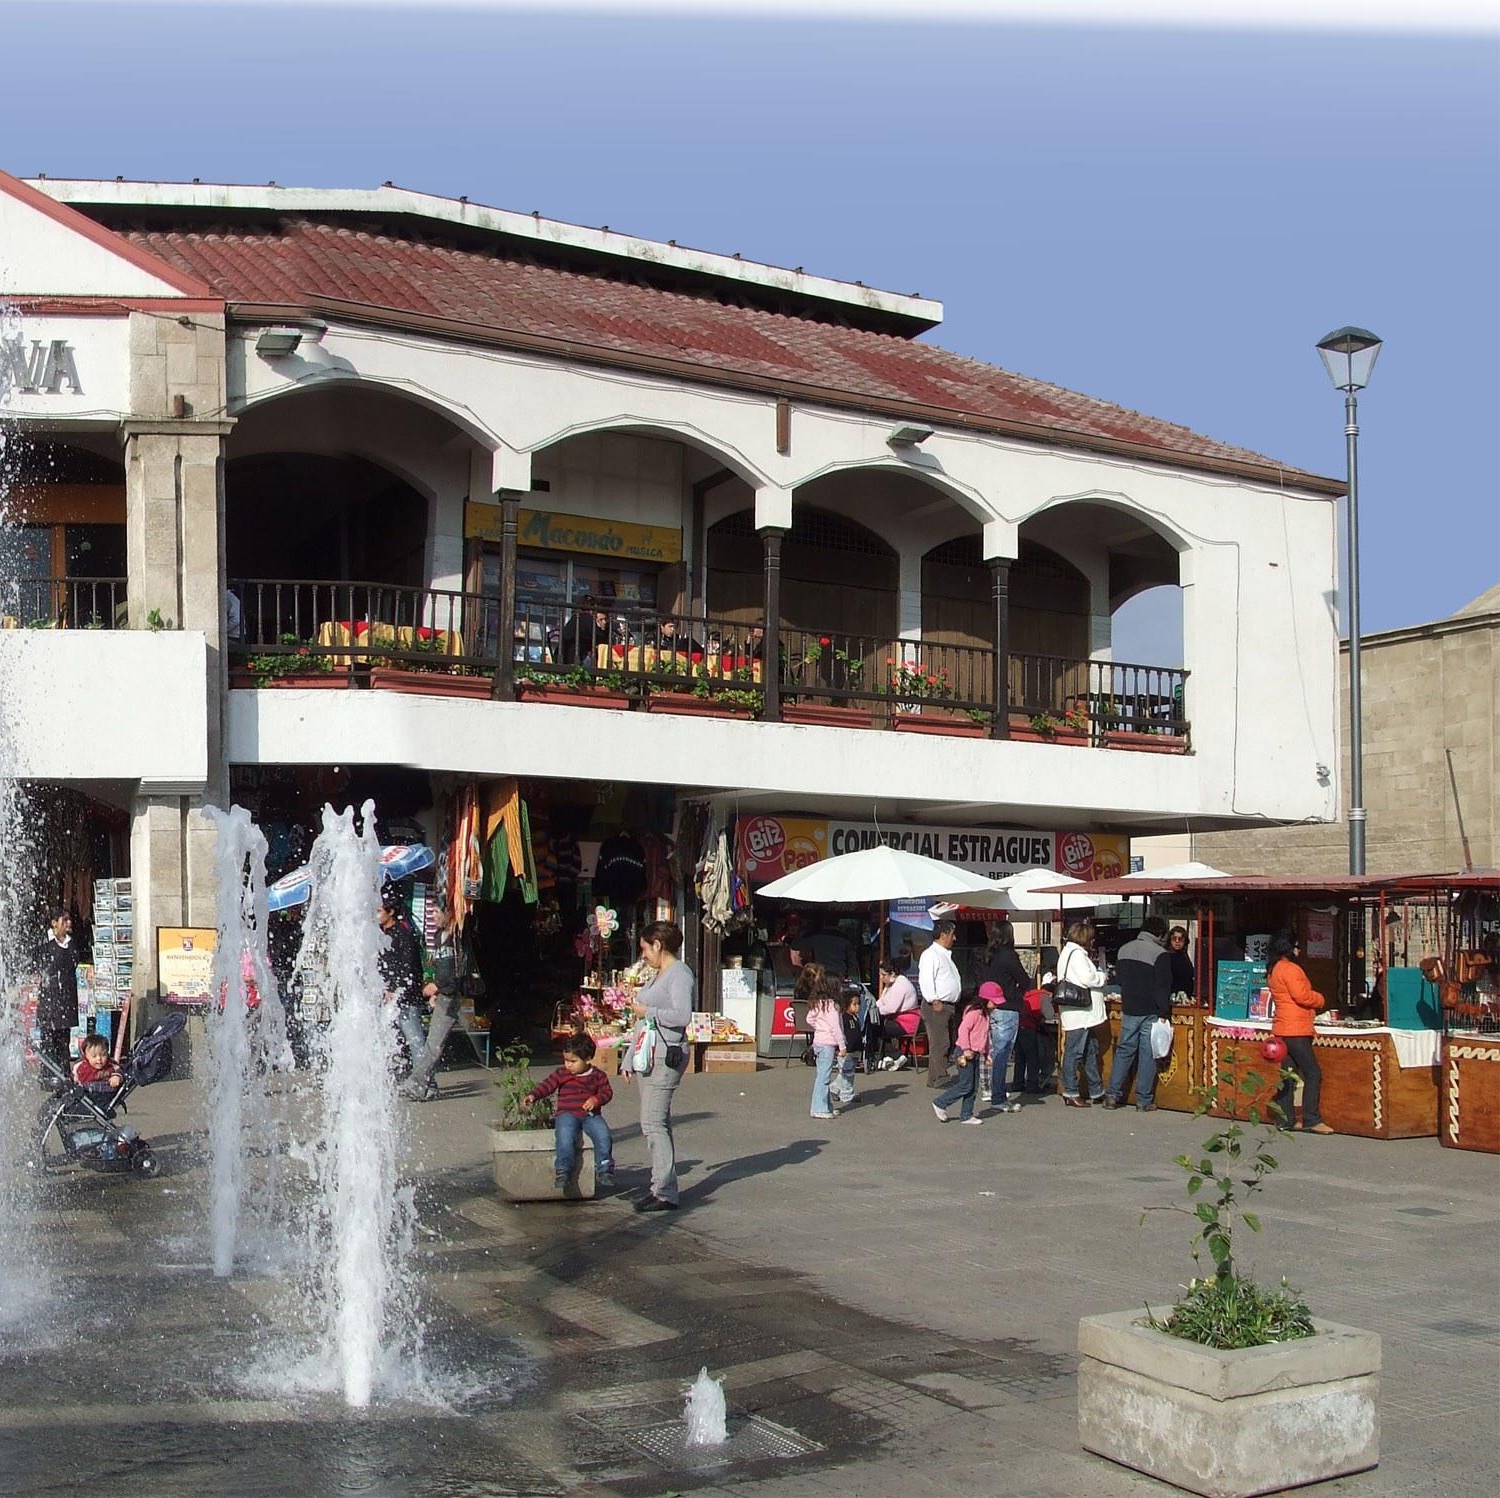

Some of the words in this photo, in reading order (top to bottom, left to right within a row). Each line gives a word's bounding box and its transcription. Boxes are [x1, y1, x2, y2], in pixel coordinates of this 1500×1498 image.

[523, 511, 623, 551] Macondo
[749, 824, 785, 853] Bilz
[832, 829, 943, 862] COMERCIAL
[948, 833, 1050, 866] ESTRAGUES
[1064, 839, 1094, 864] Bilz
[1092, 861, 1122, 879] Pap
[960, 912, 998, 921] BRESLER
